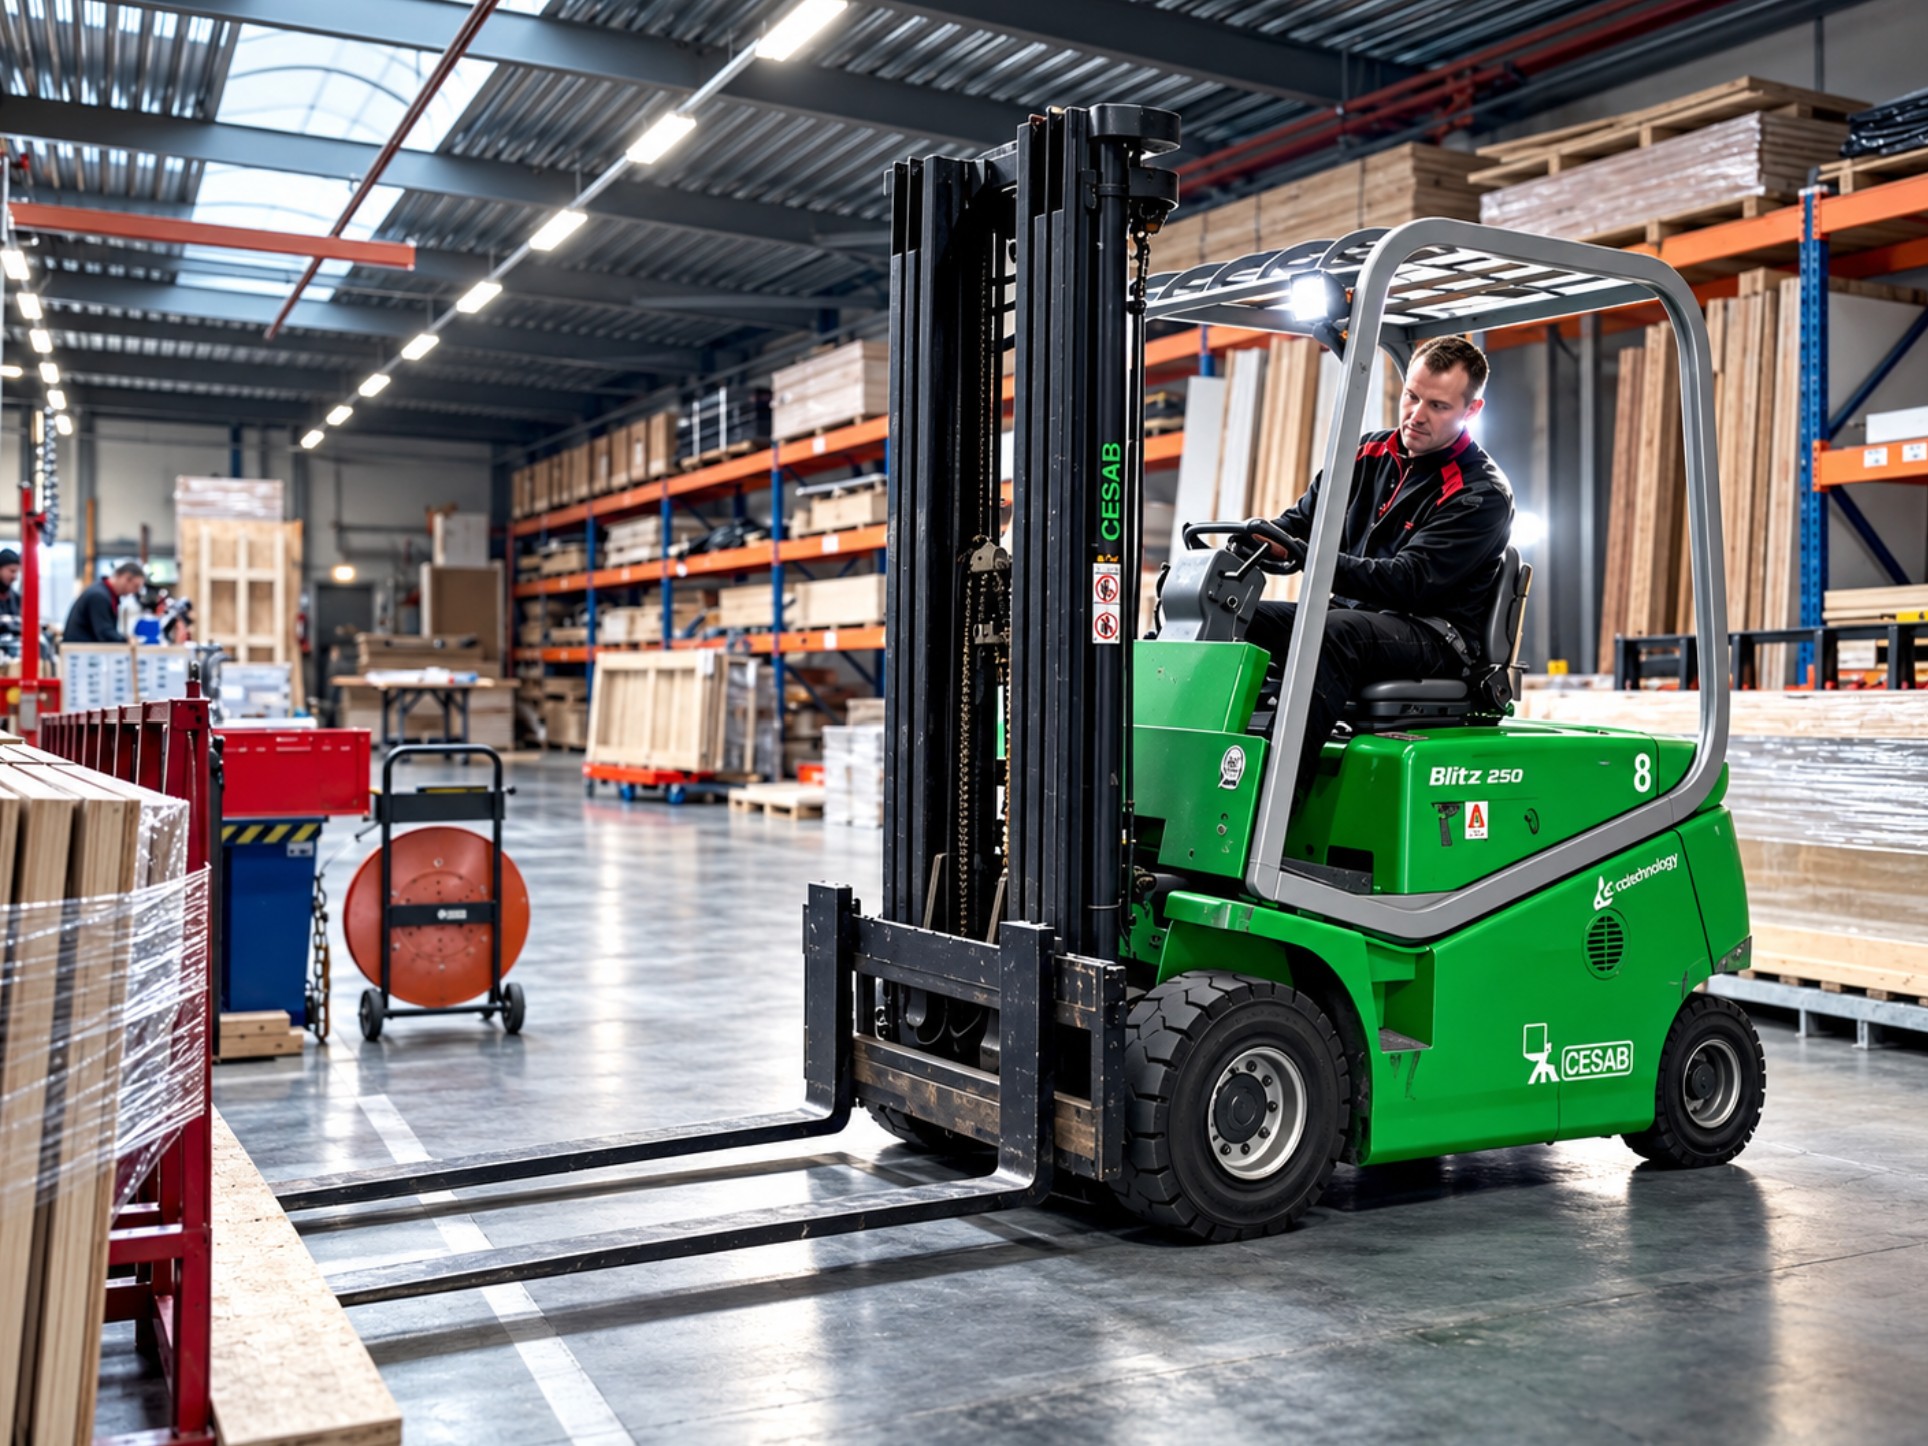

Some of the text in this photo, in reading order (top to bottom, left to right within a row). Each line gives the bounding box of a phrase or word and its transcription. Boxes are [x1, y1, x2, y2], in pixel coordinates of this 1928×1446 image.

[1101, 442, 1121, 541] CESAB
[1428, 766, 1524, 786] Blitz 250
[1633, 753, 1651, 793] 8
[1565, 1047, 1630, 1076] CESAB
